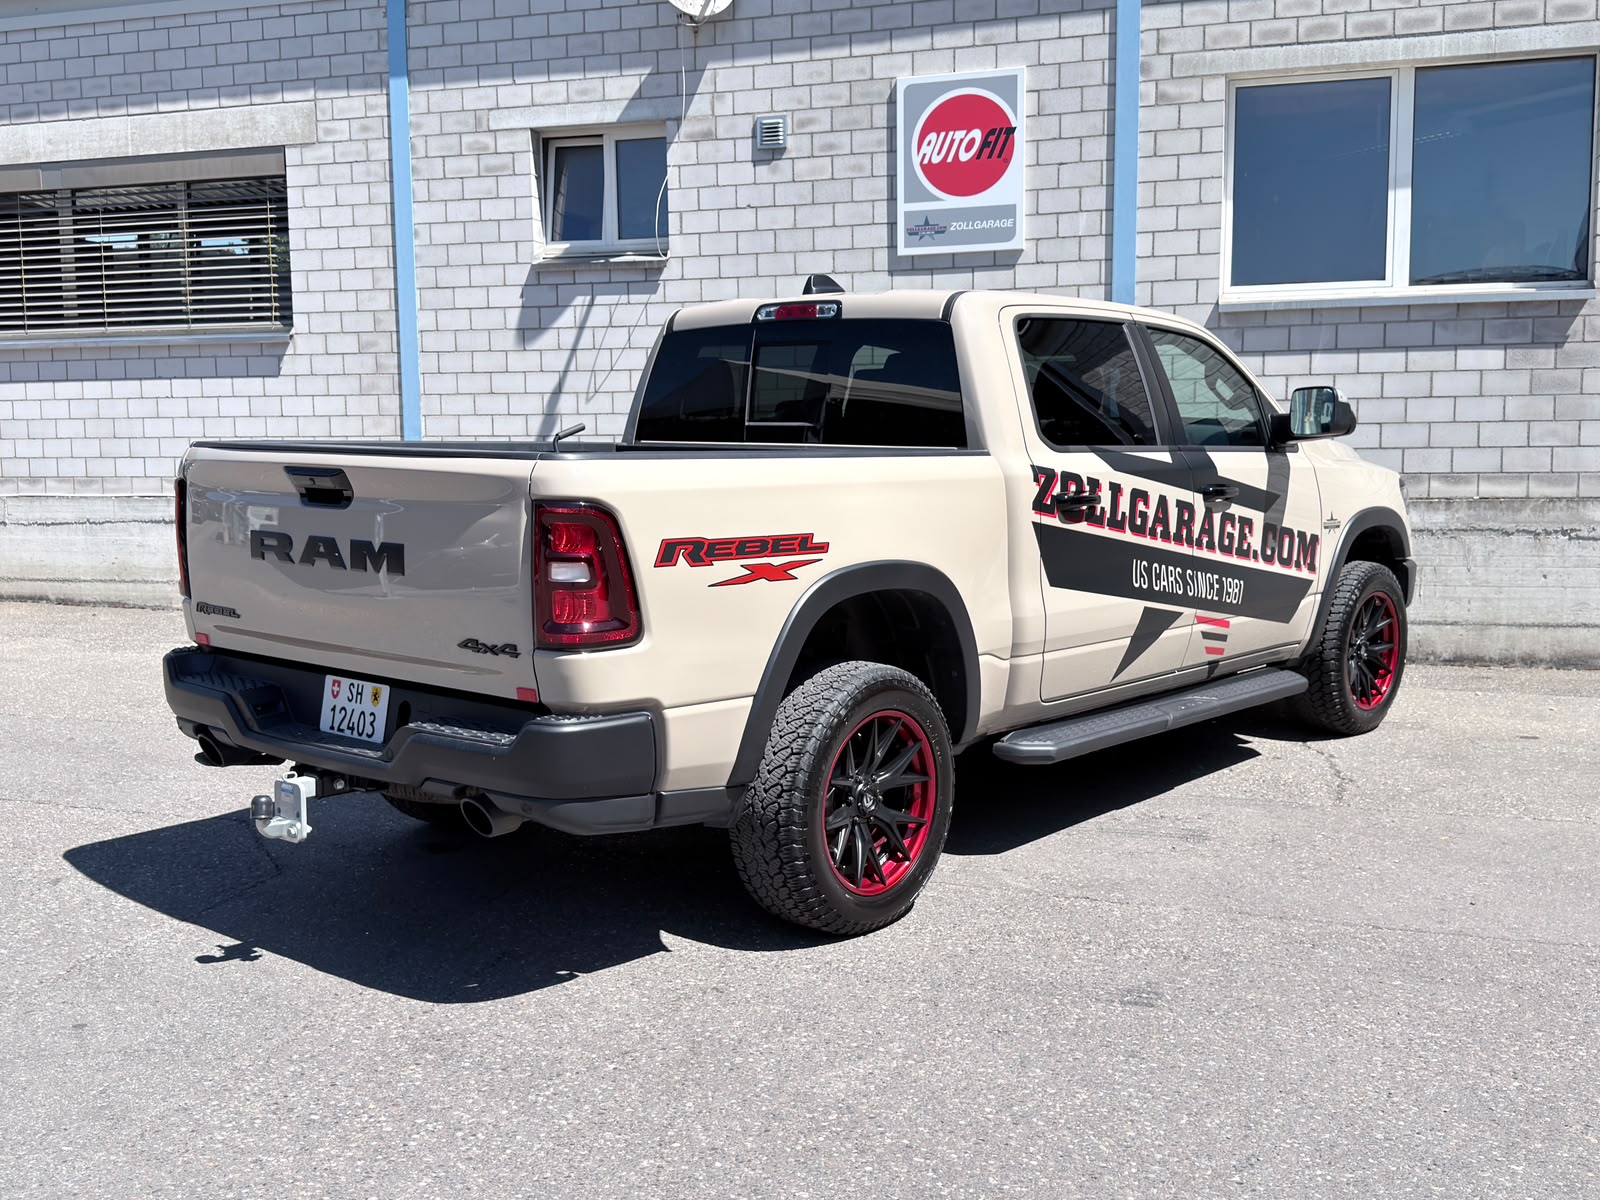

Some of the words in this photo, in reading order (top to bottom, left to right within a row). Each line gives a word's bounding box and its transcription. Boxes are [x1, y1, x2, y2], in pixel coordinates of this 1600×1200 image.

[917, 126, 1017, 165] AUTOFIT
[950, 218, 1015, 231] ZOLLGARAGE
[1030, 464, 1320, 575] ZOLLGARAGE.COM
[250, 530, 405, 576] RAM
[654, 533, 830, 568] REBEL
[708, 558, 823, 587] X
[1132, 558, 1148, 589] US
[1152, 562, 1184, 595] CARS
[1186, 569, 1220, 601] SINCE
[347, 682, 365, 704] SH
[329, 704, 377, 739] 12403
